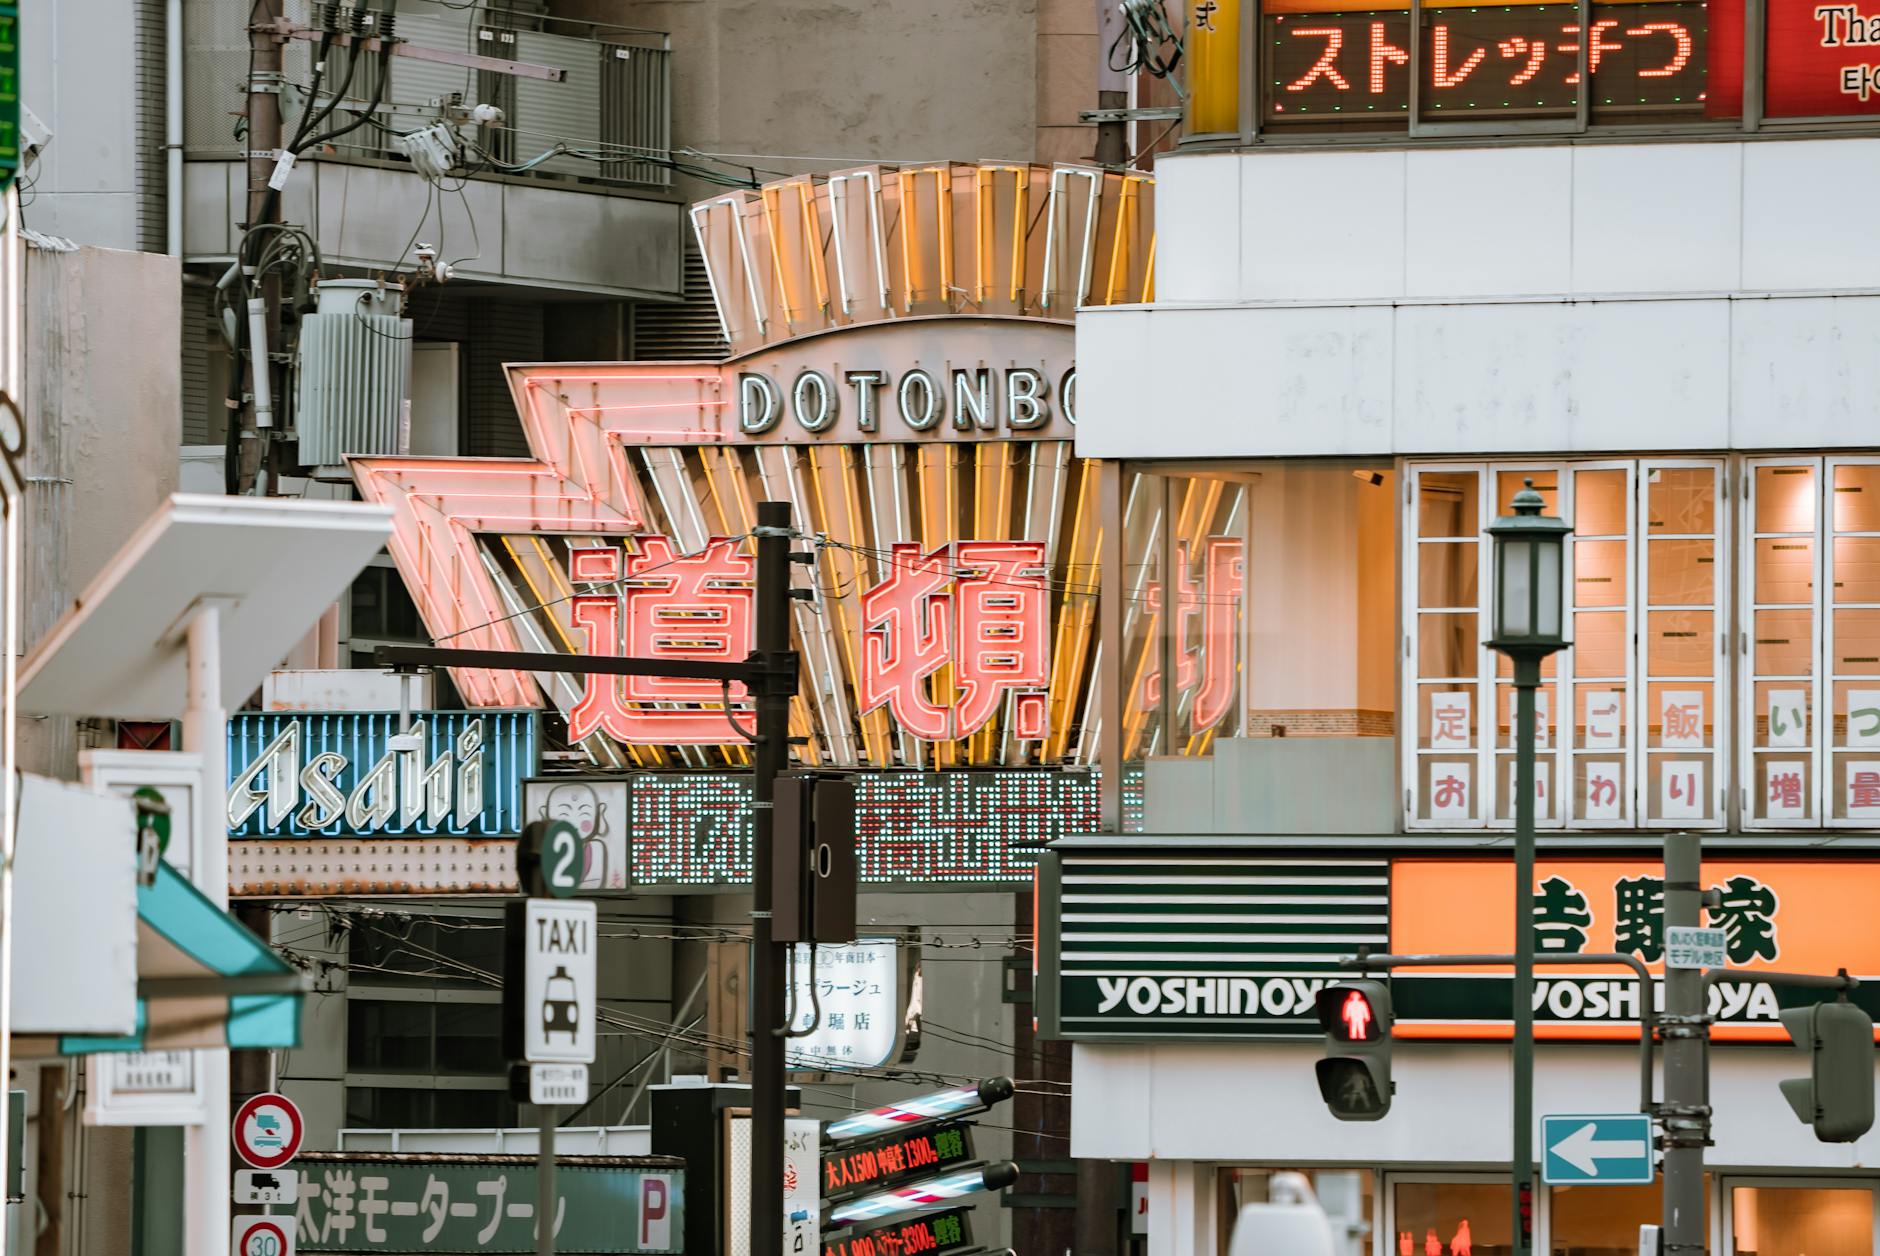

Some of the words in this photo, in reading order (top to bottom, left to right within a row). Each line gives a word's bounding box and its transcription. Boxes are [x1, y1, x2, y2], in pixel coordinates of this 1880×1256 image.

[1287, 20, 1691, 93] ストレッチつ
[228, 719, 483, 830] Asahi
[551, 833, 576, 888] 2
[537, 918, 587, 955] TAXI
[1097, 977, 1340, 1016] YOSHINOY
[642, 1179, 666, 1245] P
[251, 1236, 277, 1256] 30
